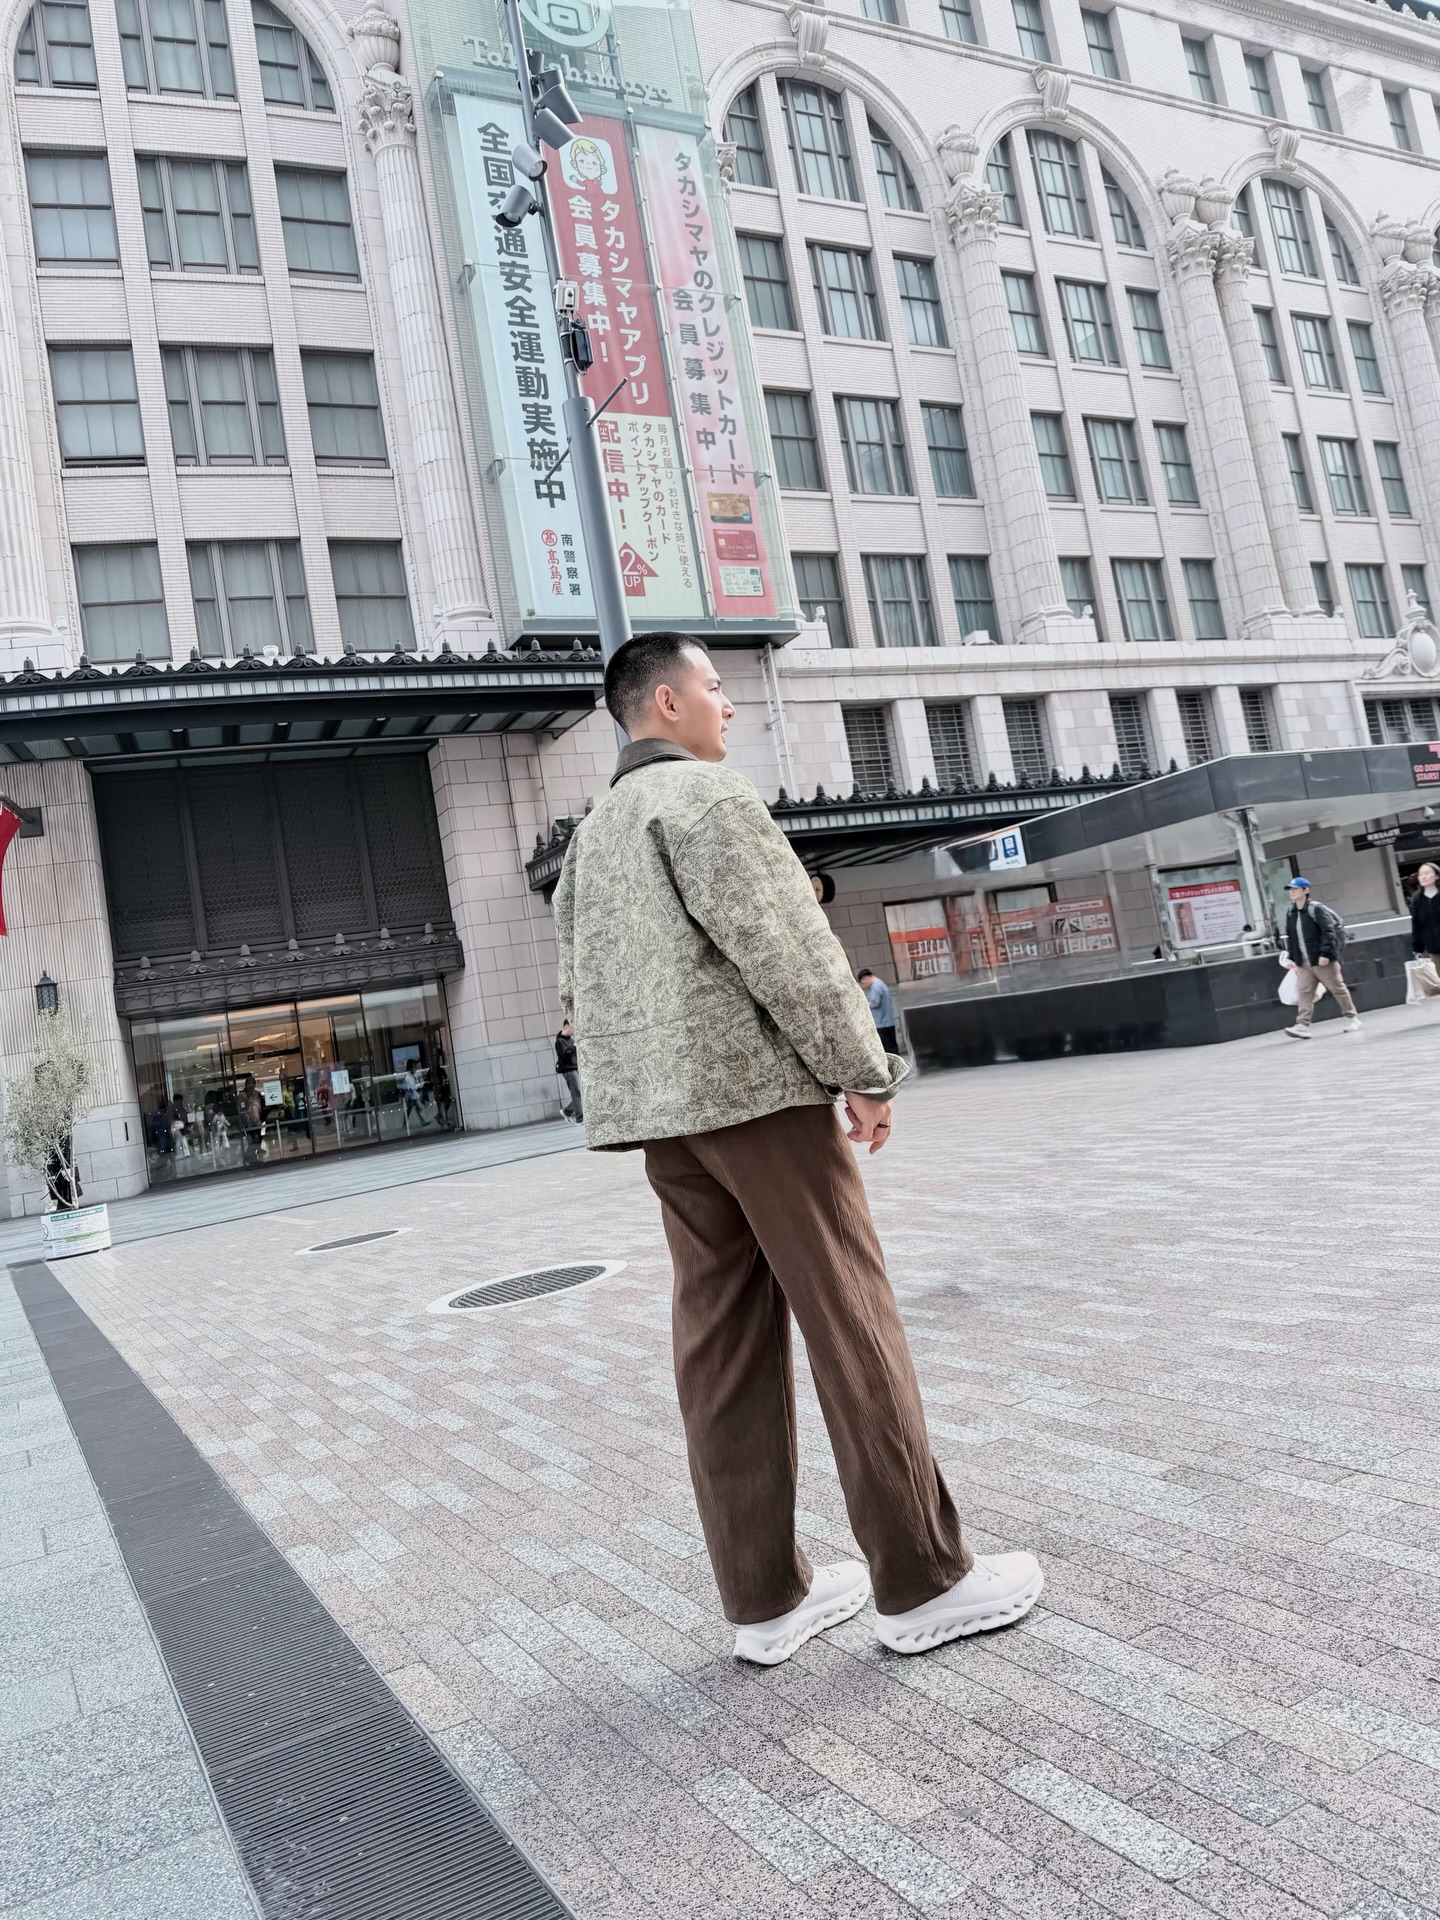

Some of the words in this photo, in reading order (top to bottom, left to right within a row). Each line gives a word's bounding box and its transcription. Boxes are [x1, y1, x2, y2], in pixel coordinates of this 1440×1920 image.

[568, 194, 611, 363] 会員募集中!
[600, 200, 649, 405] タカシマヤアプリ
[674, 151, 746, 485] タカシマヤのクレジットカード
[672, 288, 717, 485] 会員募集中!
[598, 419, 630, 530] 配信中!
[628, 421, 659, 562] ポイントアップクーポン
[642, 422, 671, 545] タカシマヤのカード
[657, 423, 693, 589] 毎月お届け、お好きな時に使える
[561, 533, 581, 596] 南警察署
[624, 576, 641, 588] UP
